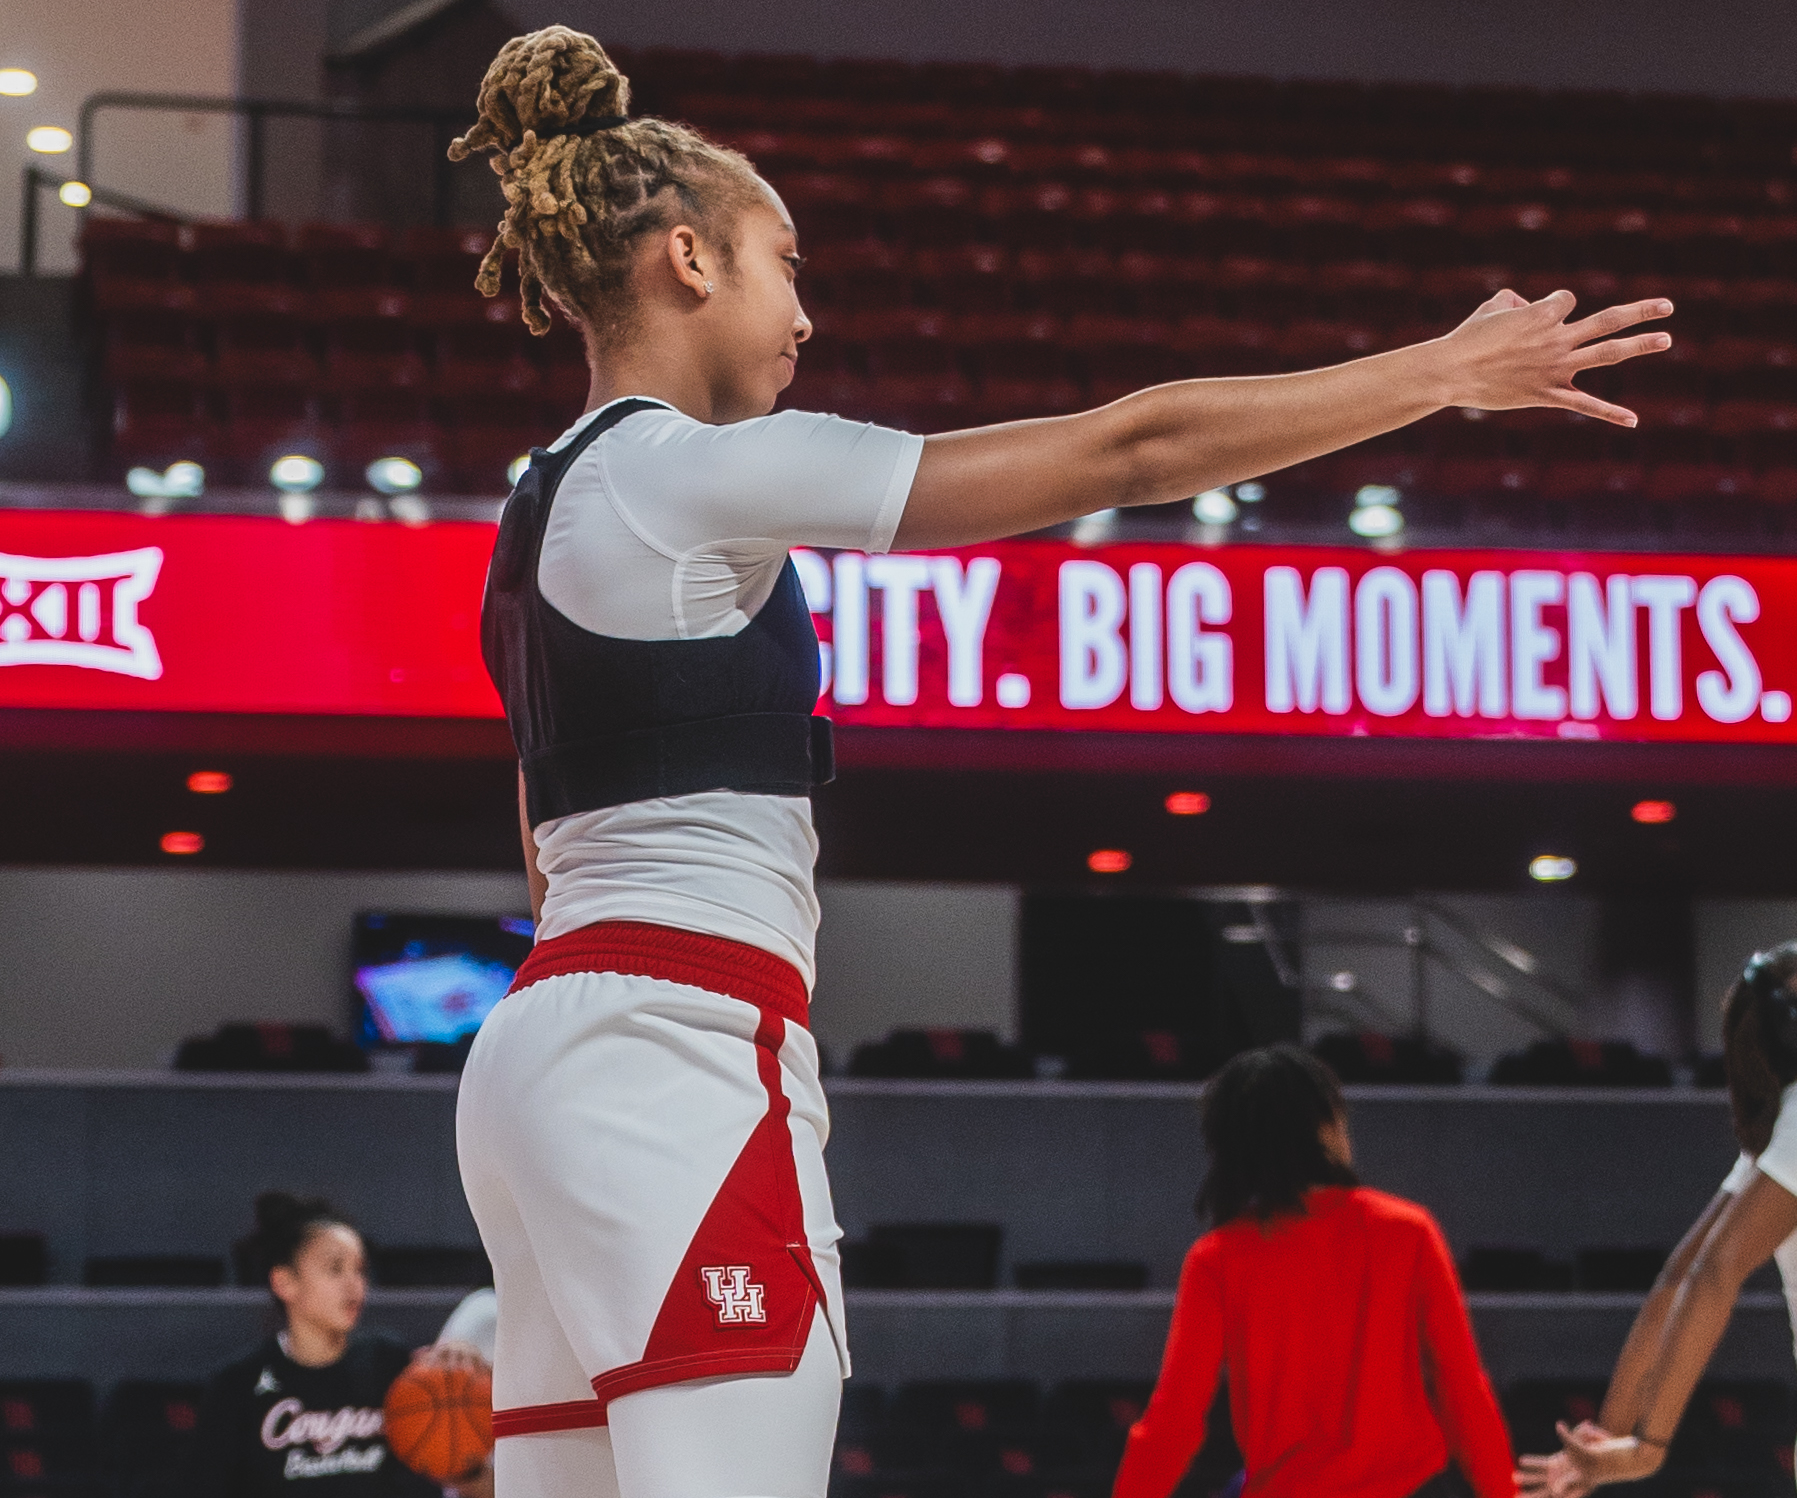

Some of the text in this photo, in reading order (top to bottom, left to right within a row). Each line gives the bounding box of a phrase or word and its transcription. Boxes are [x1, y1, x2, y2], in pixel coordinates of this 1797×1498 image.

[1059, 559, 1233, 714] BIG
[1263, 565, 1791, 724] MOMENTS.
[701, 1266, 767, 1323] UH
